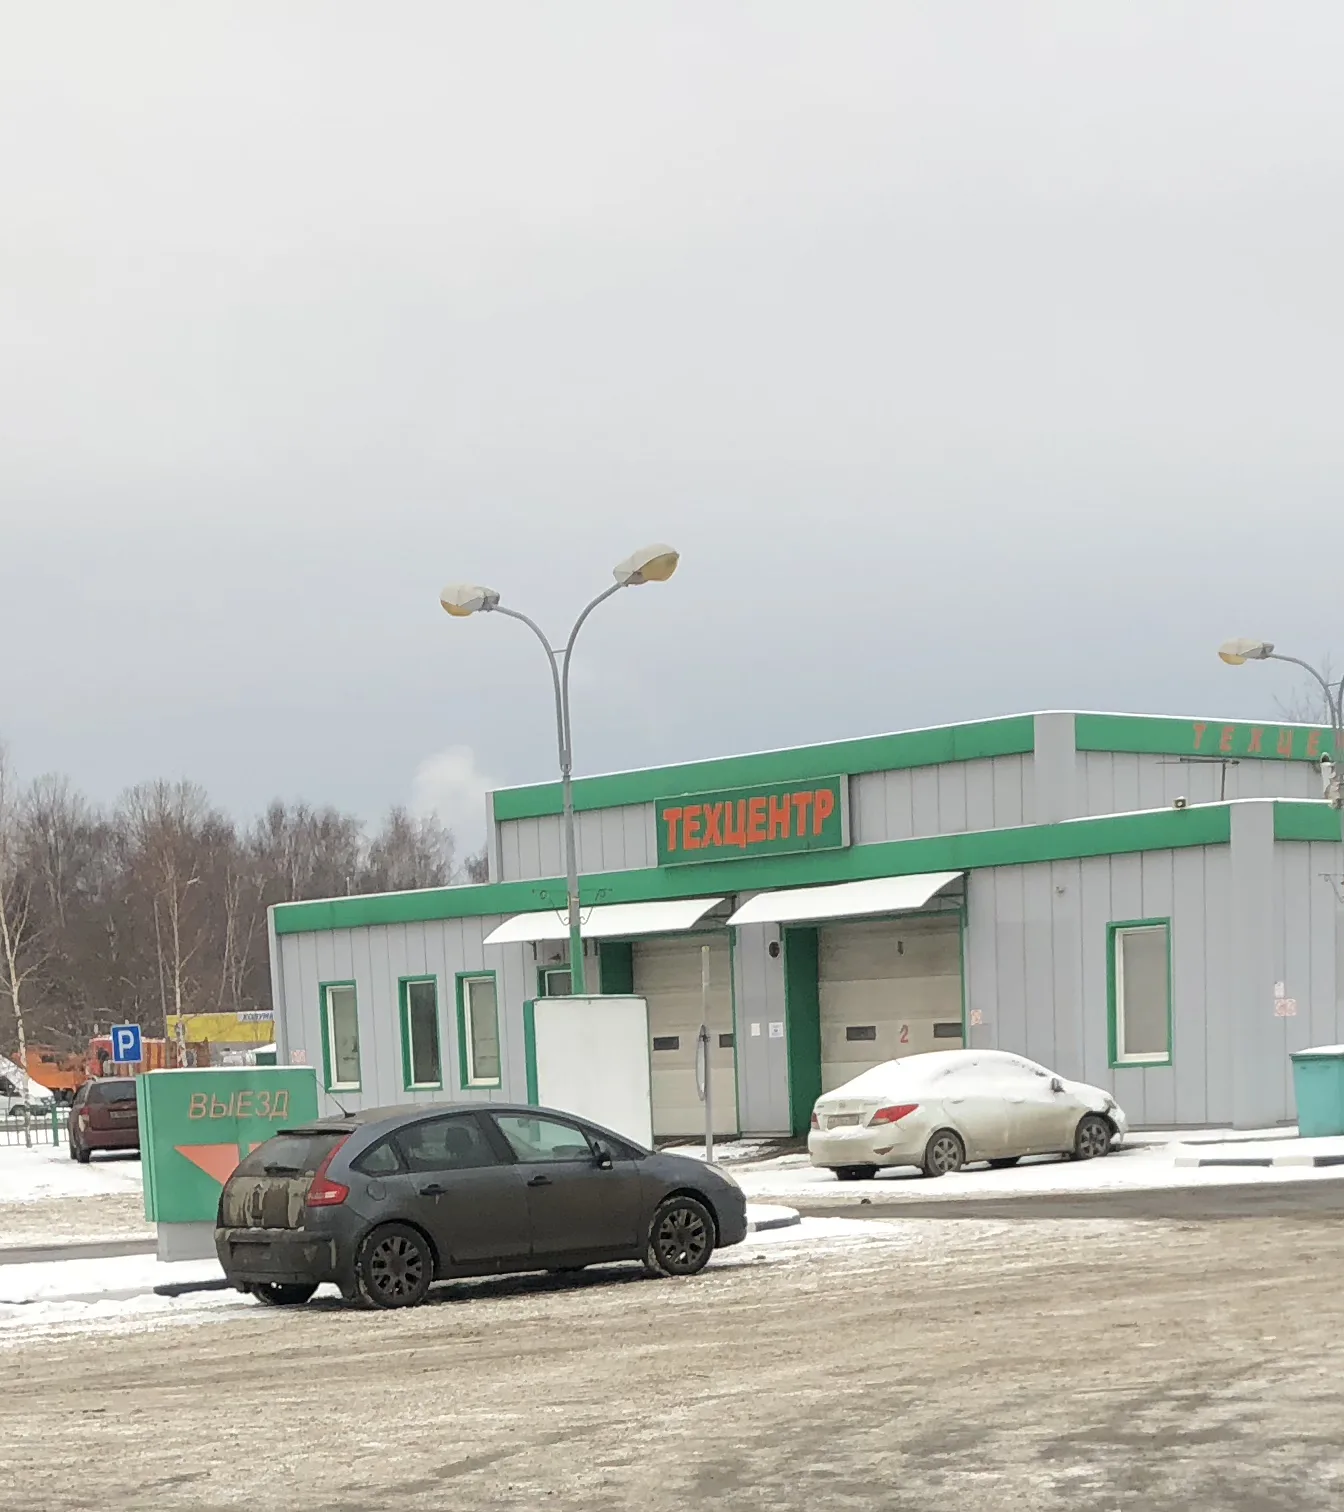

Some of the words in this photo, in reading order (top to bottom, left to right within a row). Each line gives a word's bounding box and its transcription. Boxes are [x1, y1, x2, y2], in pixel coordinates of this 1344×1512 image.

[662, 788, 835, 852] ТЕХЦЕНТР
[118, 1030, 135, 1059] P
[900, 1023, 910, 1044] 2
[188, 1089, 289, 1121] ВЫЕЗД
